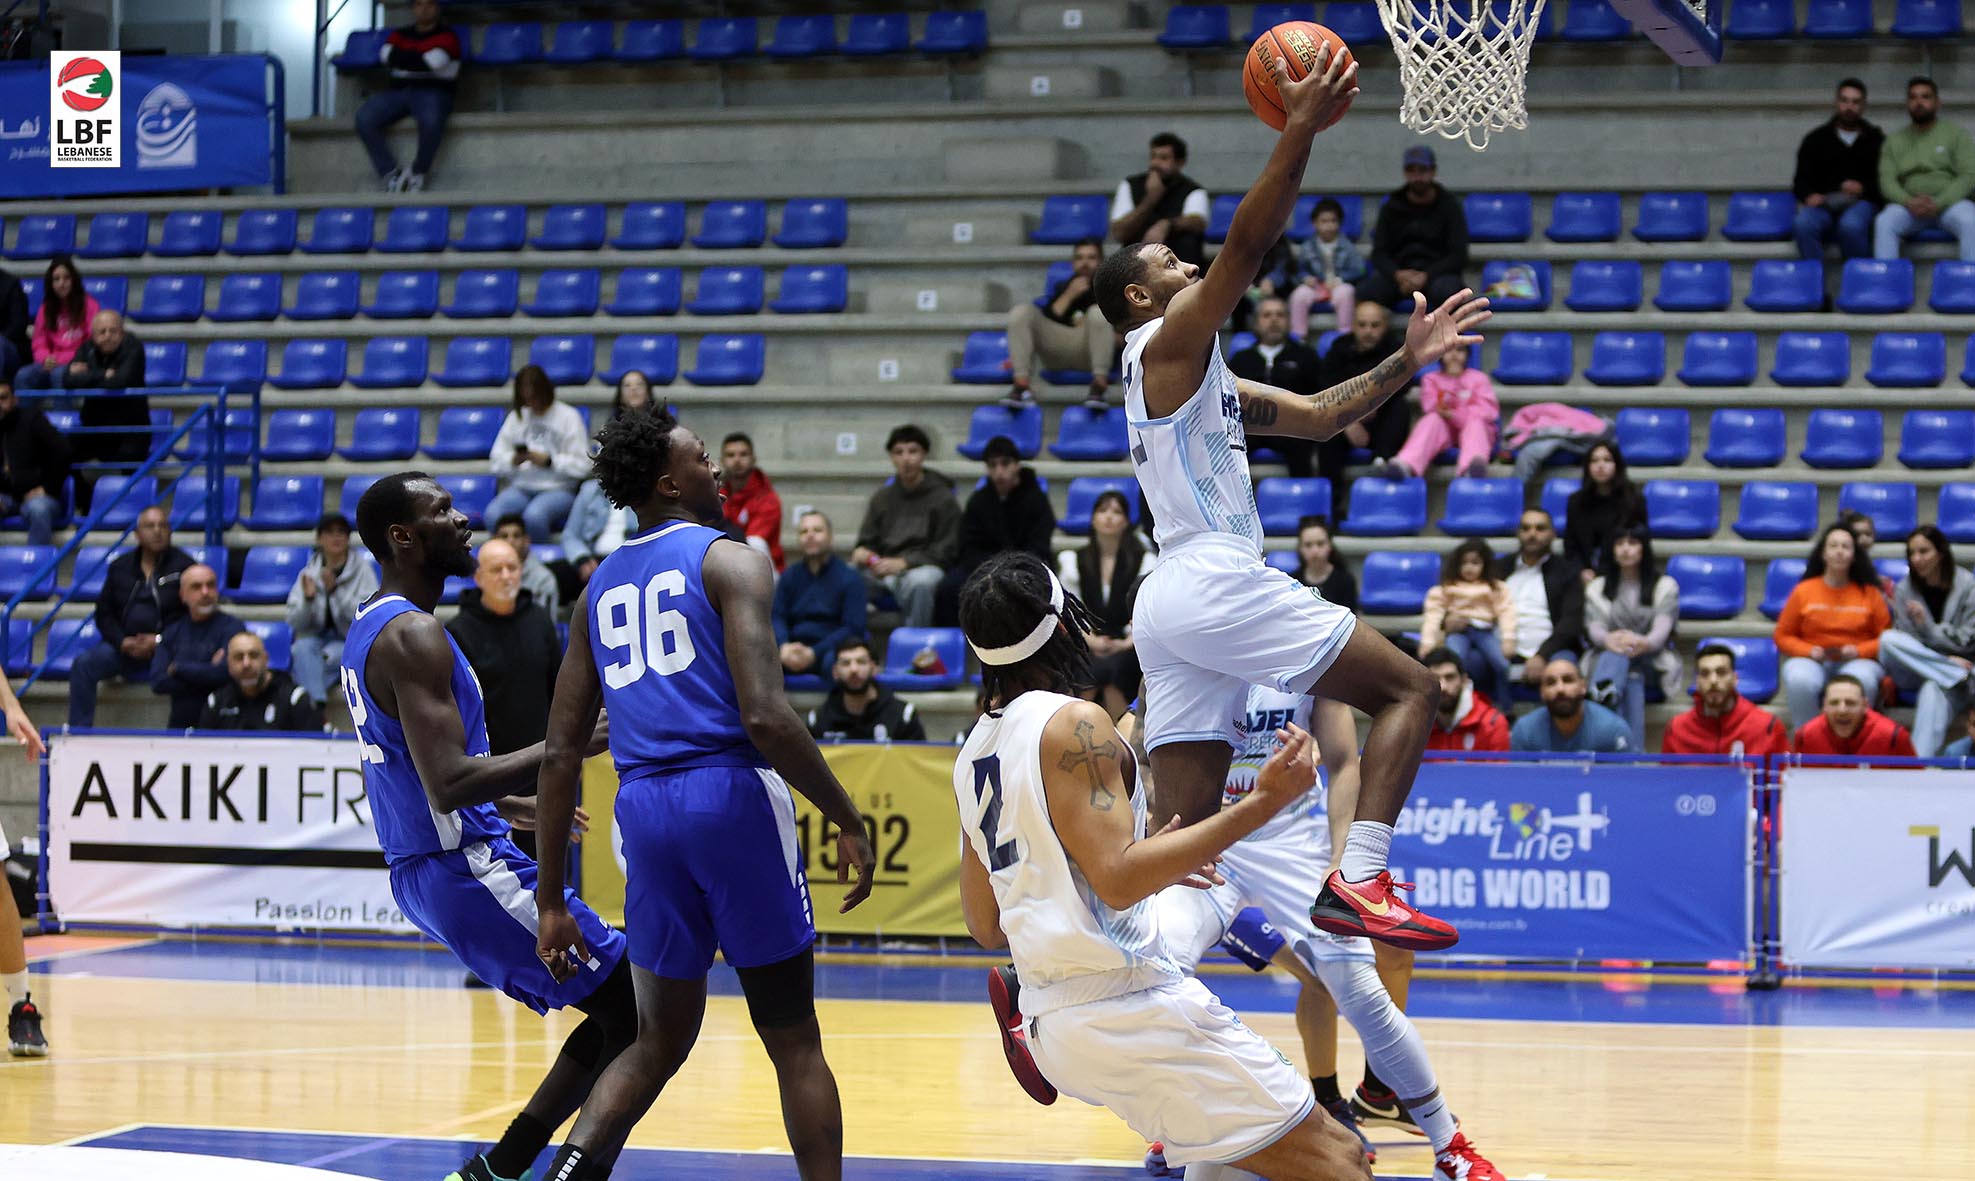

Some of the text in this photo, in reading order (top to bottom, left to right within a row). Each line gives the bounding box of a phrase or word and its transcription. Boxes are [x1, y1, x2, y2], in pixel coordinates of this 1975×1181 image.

[597, 568, 697, 690] 96
[71, 761, 366, 826] AKIKI FR
[971, 752, 1020, 873] 2
[1489, 817, 1575, 861] Line
[255, 897, 352, 922] Passion
[1413, 867, 1477, 908] BIG
[1482, 868, 1611, 911] WORLD
